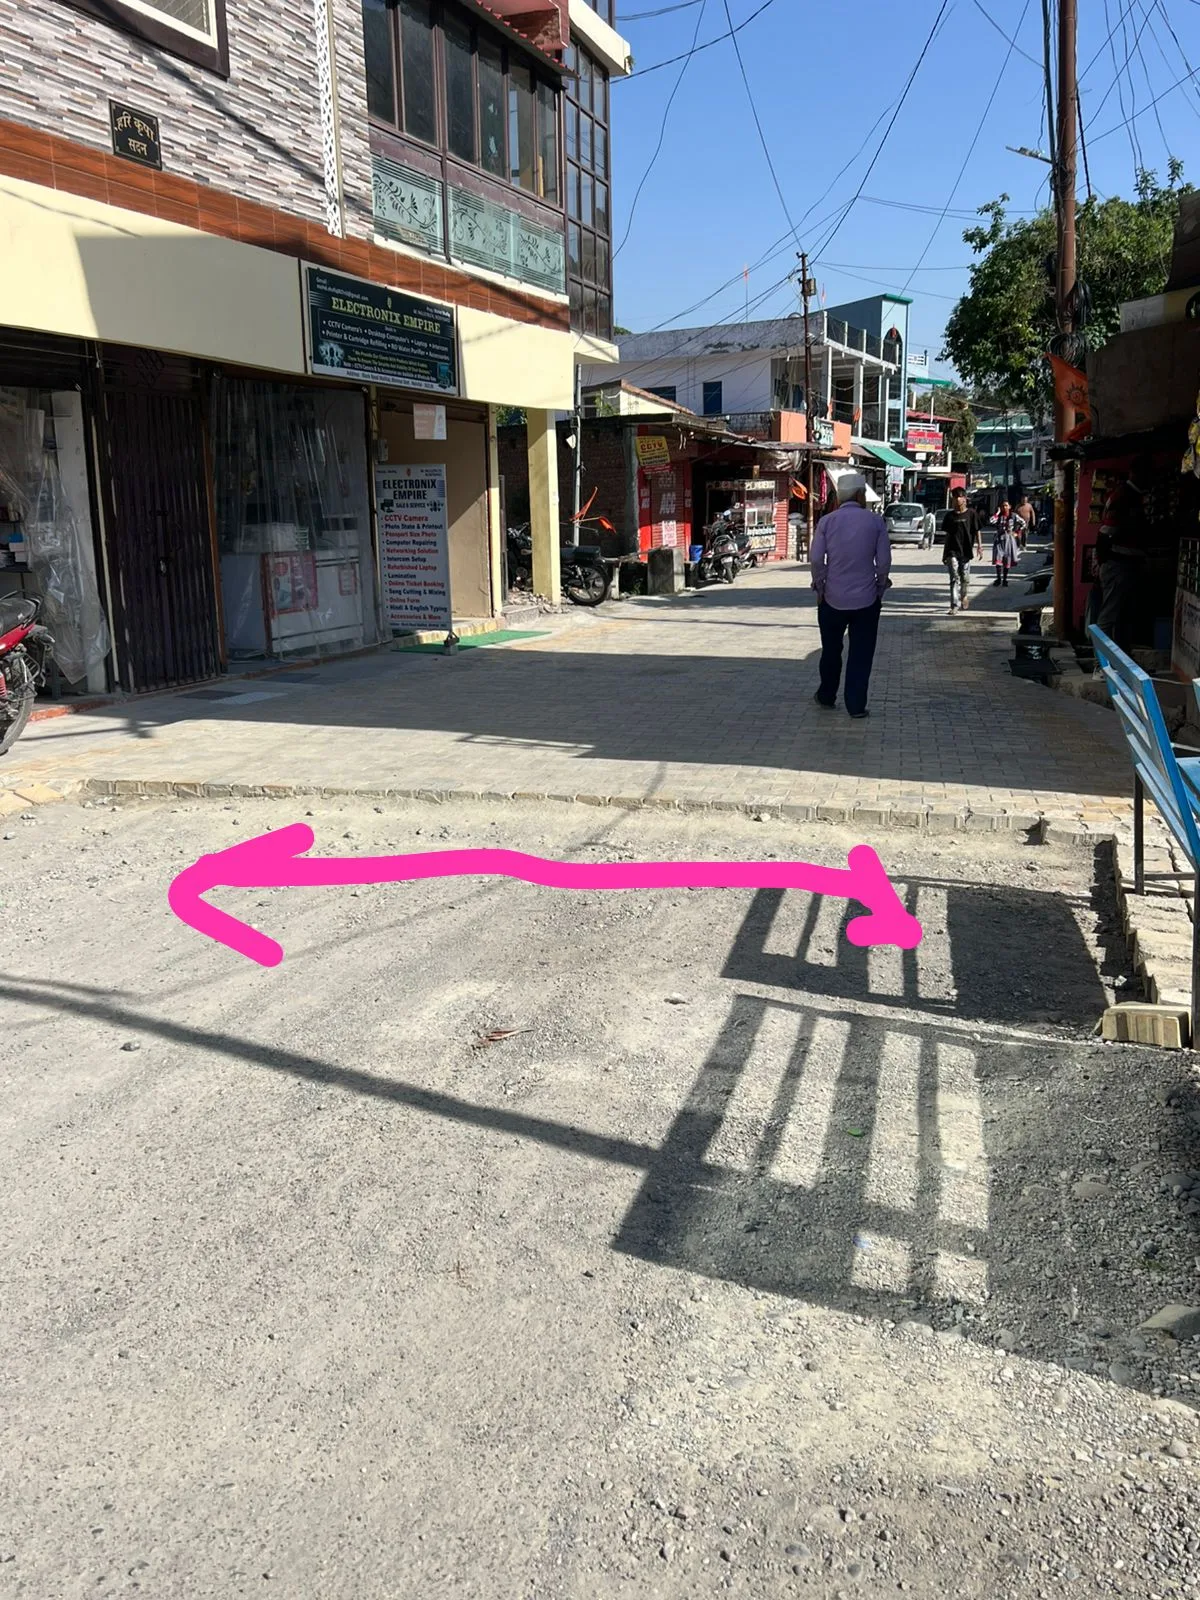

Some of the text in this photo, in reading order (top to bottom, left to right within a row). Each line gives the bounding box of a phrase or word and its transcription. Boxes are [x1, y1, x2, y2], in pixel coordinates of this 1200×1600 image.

[116, 111, 154, 141] हरि कृपा
[128, 138, 148, 156] सदन
[331, 296, 400, 324] ELECTRONIX
[403, 314, 440, 334] EMPIRE
[328, 320, 341, 329] CCTV
[382, 478, 436, 489] ELECTRONIX
[393, 490, 427, 499] EMPIRE
